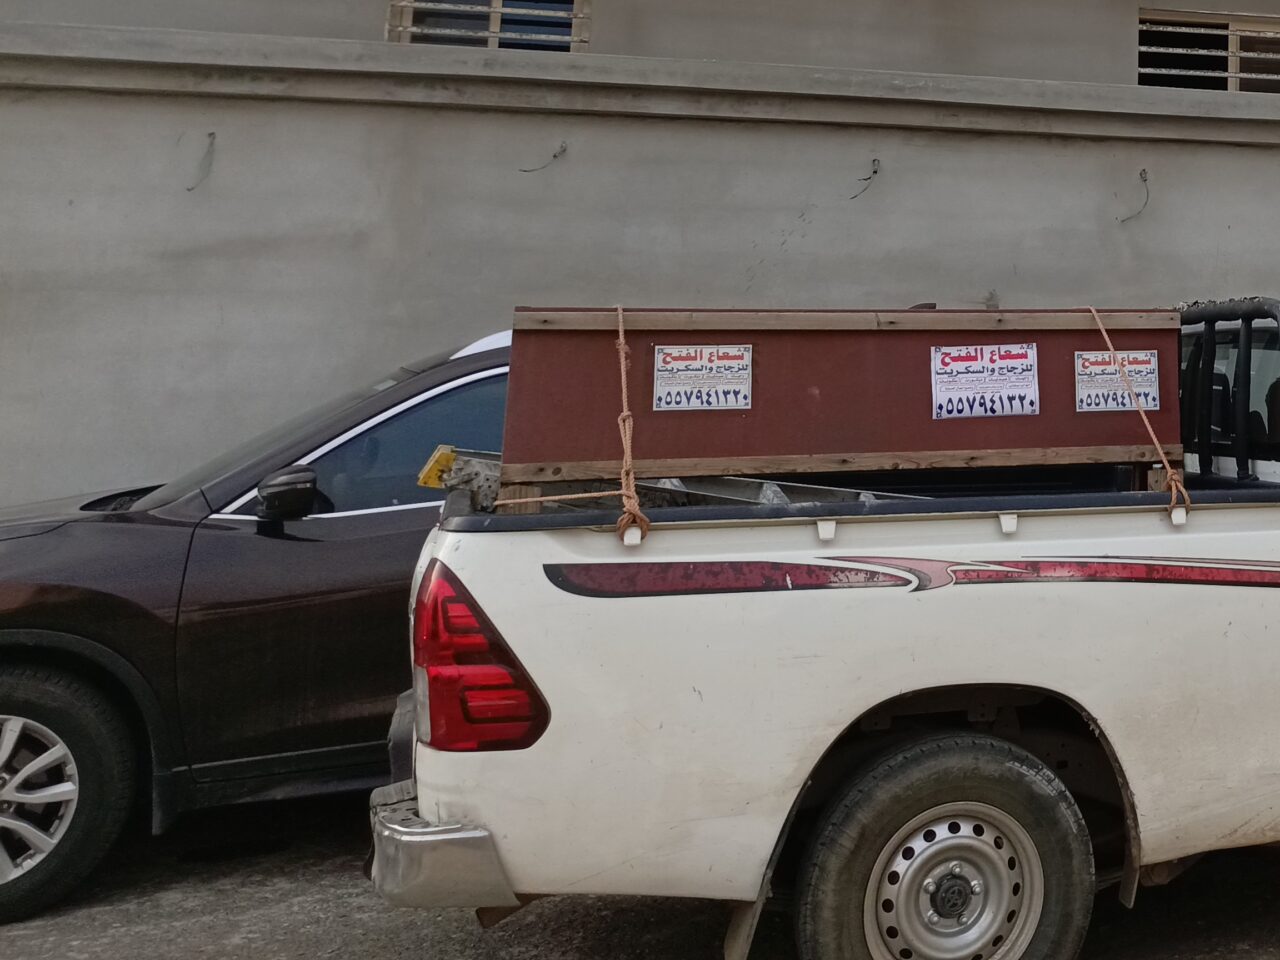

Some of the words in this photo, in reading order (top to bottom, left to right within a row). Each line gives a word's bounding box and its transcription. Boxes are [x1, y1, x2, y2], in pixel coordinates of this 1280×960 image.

[662, 348, 704, 365] الفتح
[708, 347, 745, 363] شعاع
[941, 347, 984, 367] الفتح
[989, 345, 1028, 364] شعاع
[998, 363, 1033, 375] للزجاج
[937, 393, 1035, 415] ٠٥٥٧٩٤١٣٢٠
